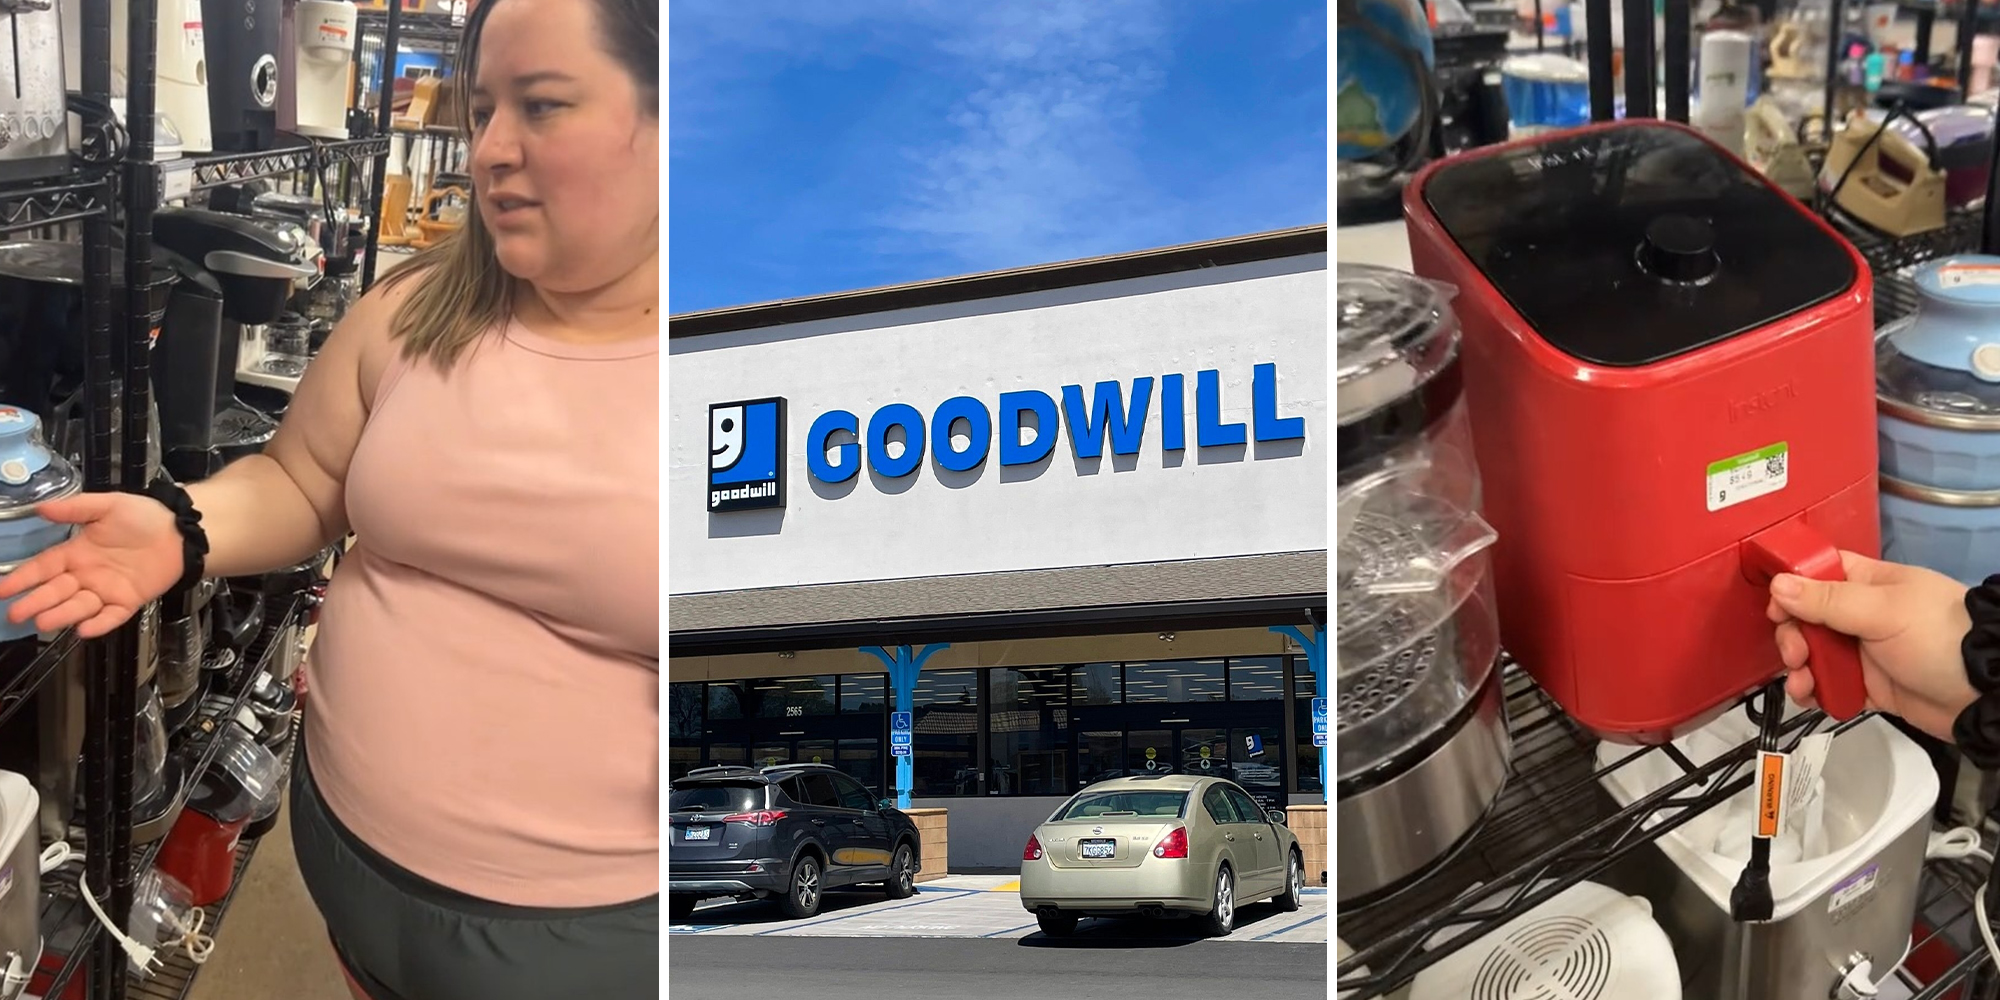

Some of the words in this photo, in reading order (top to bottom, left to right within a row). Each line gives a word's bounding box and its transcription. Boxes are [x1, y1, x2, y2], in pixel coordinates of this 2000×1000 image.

[807, 362, 1305, 483] GOODWILL
[711, 481, 776, 508] goodwill
[786, 706, 803, 717] 2565
[1766, 773, 1775, 809] WARNING
